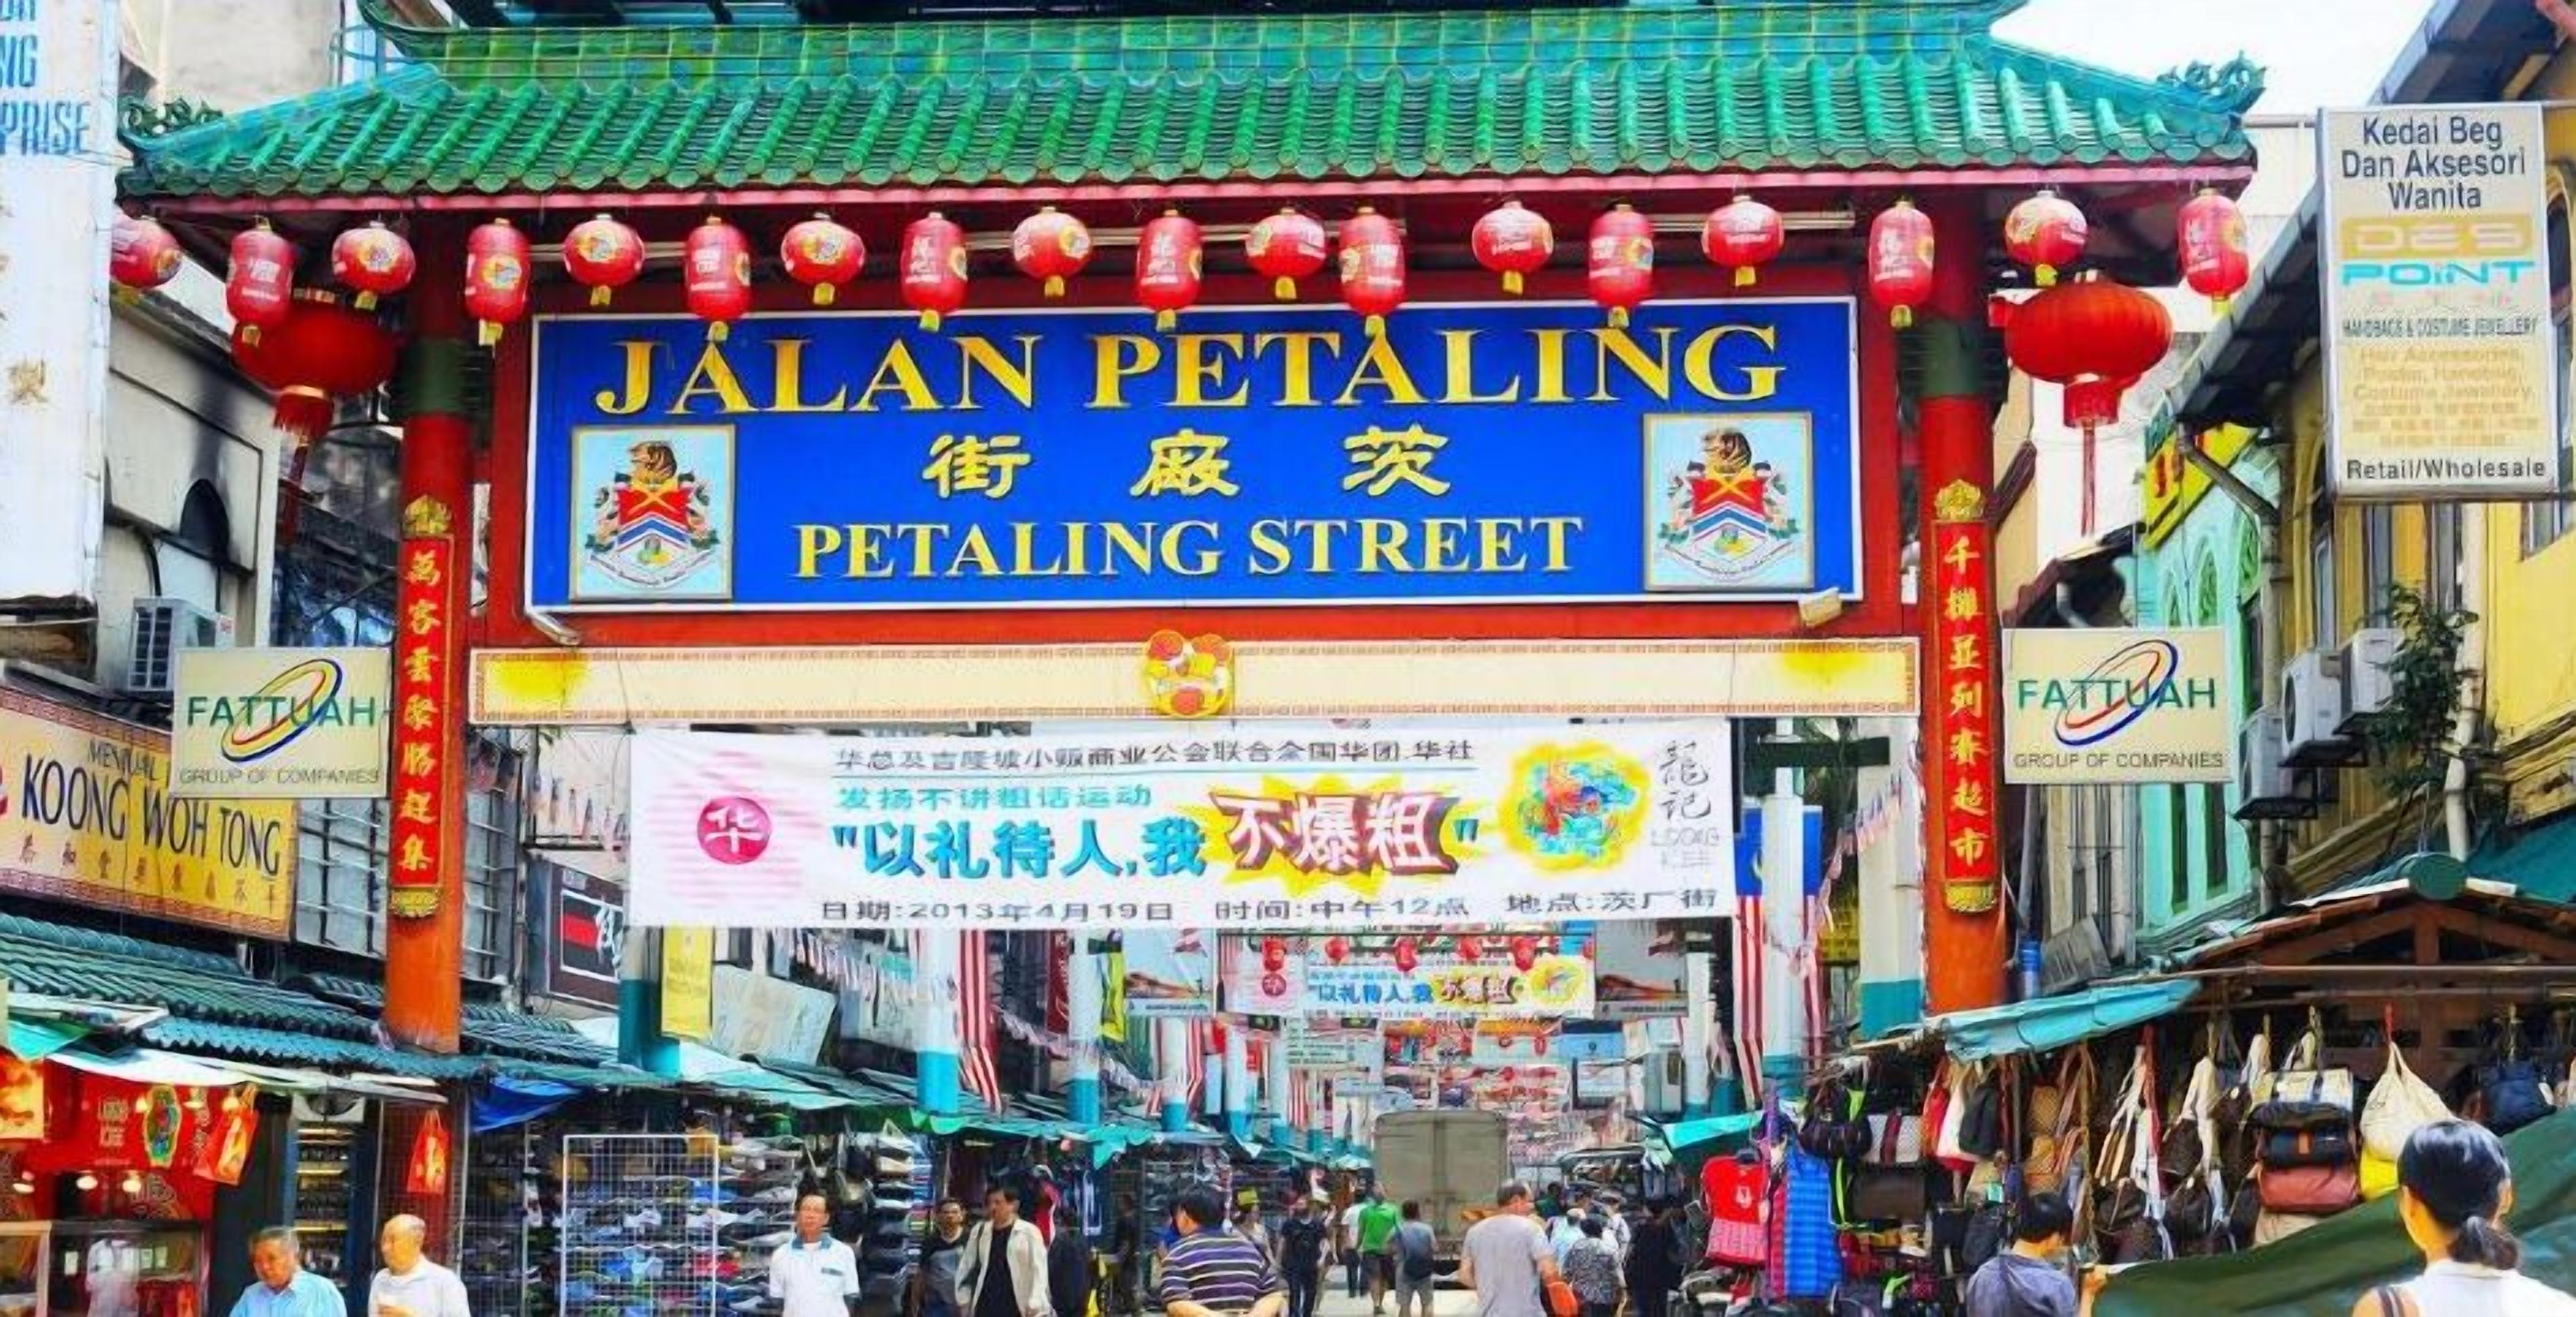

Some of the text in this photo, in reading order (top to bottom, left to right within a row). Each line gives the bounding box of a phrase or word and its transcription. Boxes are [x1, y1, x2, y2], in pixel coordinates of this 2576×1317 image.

[2362, 116, 2503, 150] Kedai Beg
[2341, 147, 2526, 179] Dan Aksesori
[2388, 182, 2482, 210] Wanita
[596, 323, 1786, 416] JALAN PETALING
[2346, 459, 2546, 480] Retail/Wholesale
[791, 516, 1584, 579] PETALING STREET
[2017, 678, 2215, 710] FATTUAH
[186, 696, 374, 727] FATTUAH
[2014, 752, 2224, 769] GROUP OF COMPANIES
[22, 754, 126, 841] KOONG
[143, 787, 207, 858] WOH
[219, 805, 281, 876] TONG
